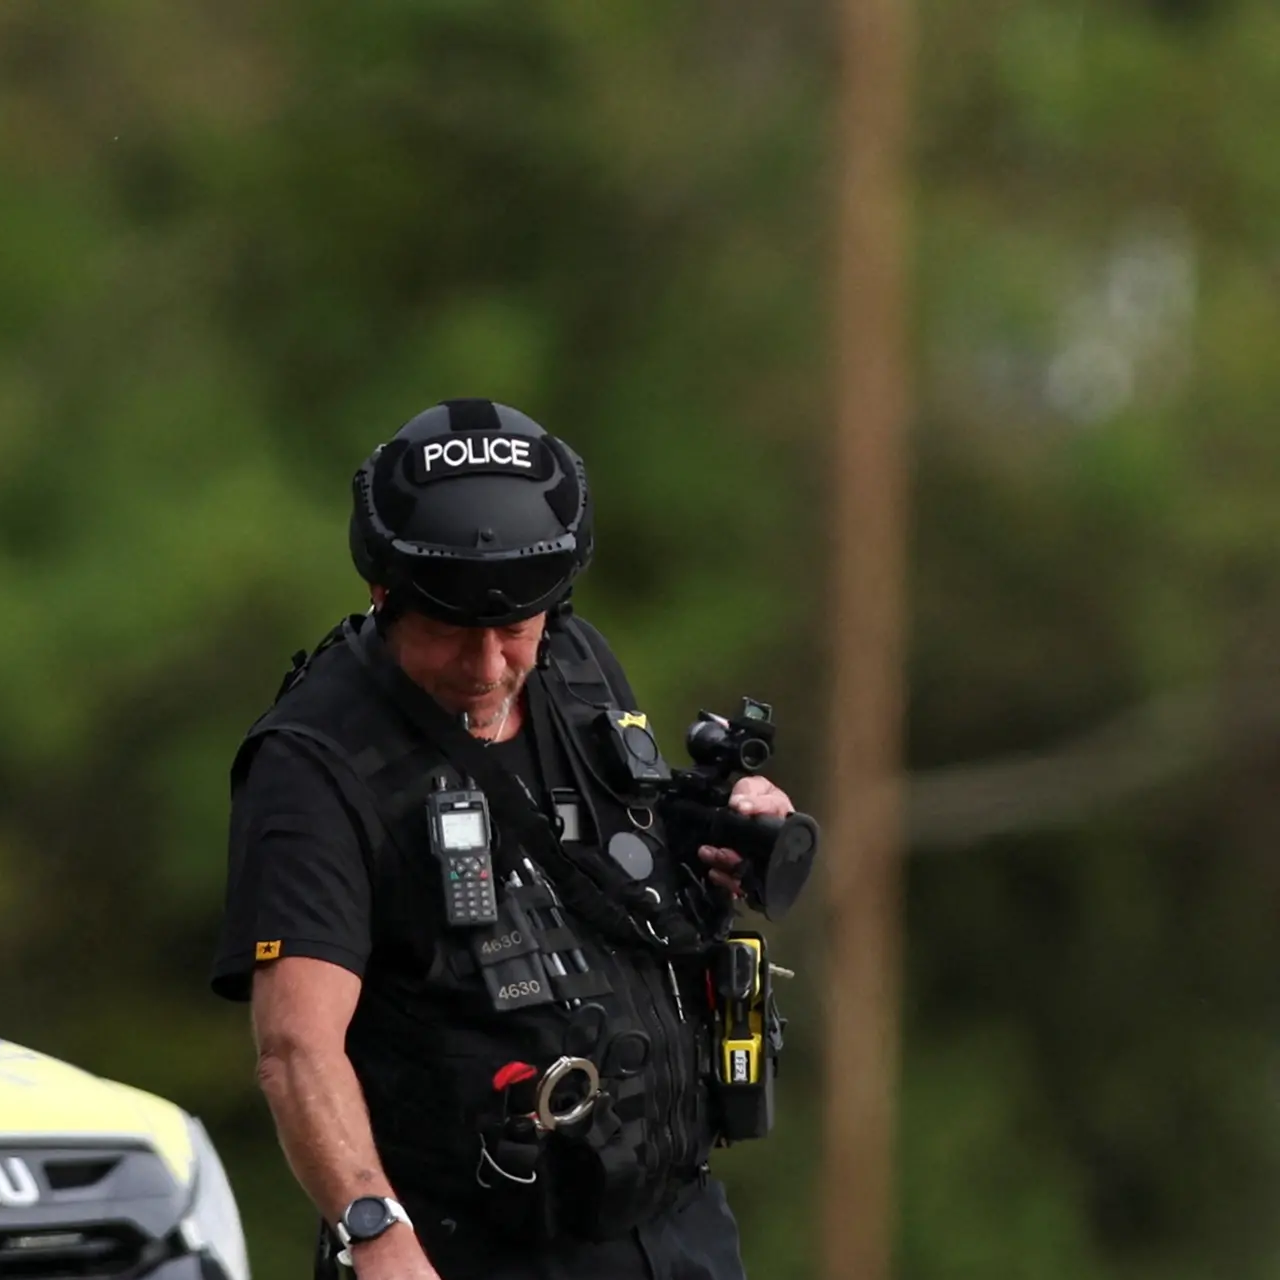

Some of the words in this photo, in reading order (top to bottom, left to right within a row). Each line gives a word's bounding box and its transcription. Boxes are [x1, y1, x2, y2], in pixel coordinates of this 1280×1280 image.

[423, 437, 532, 472] POLICE
[481, 930, 522, 954] 4630
[498, 980, 540, 1000] 4630
